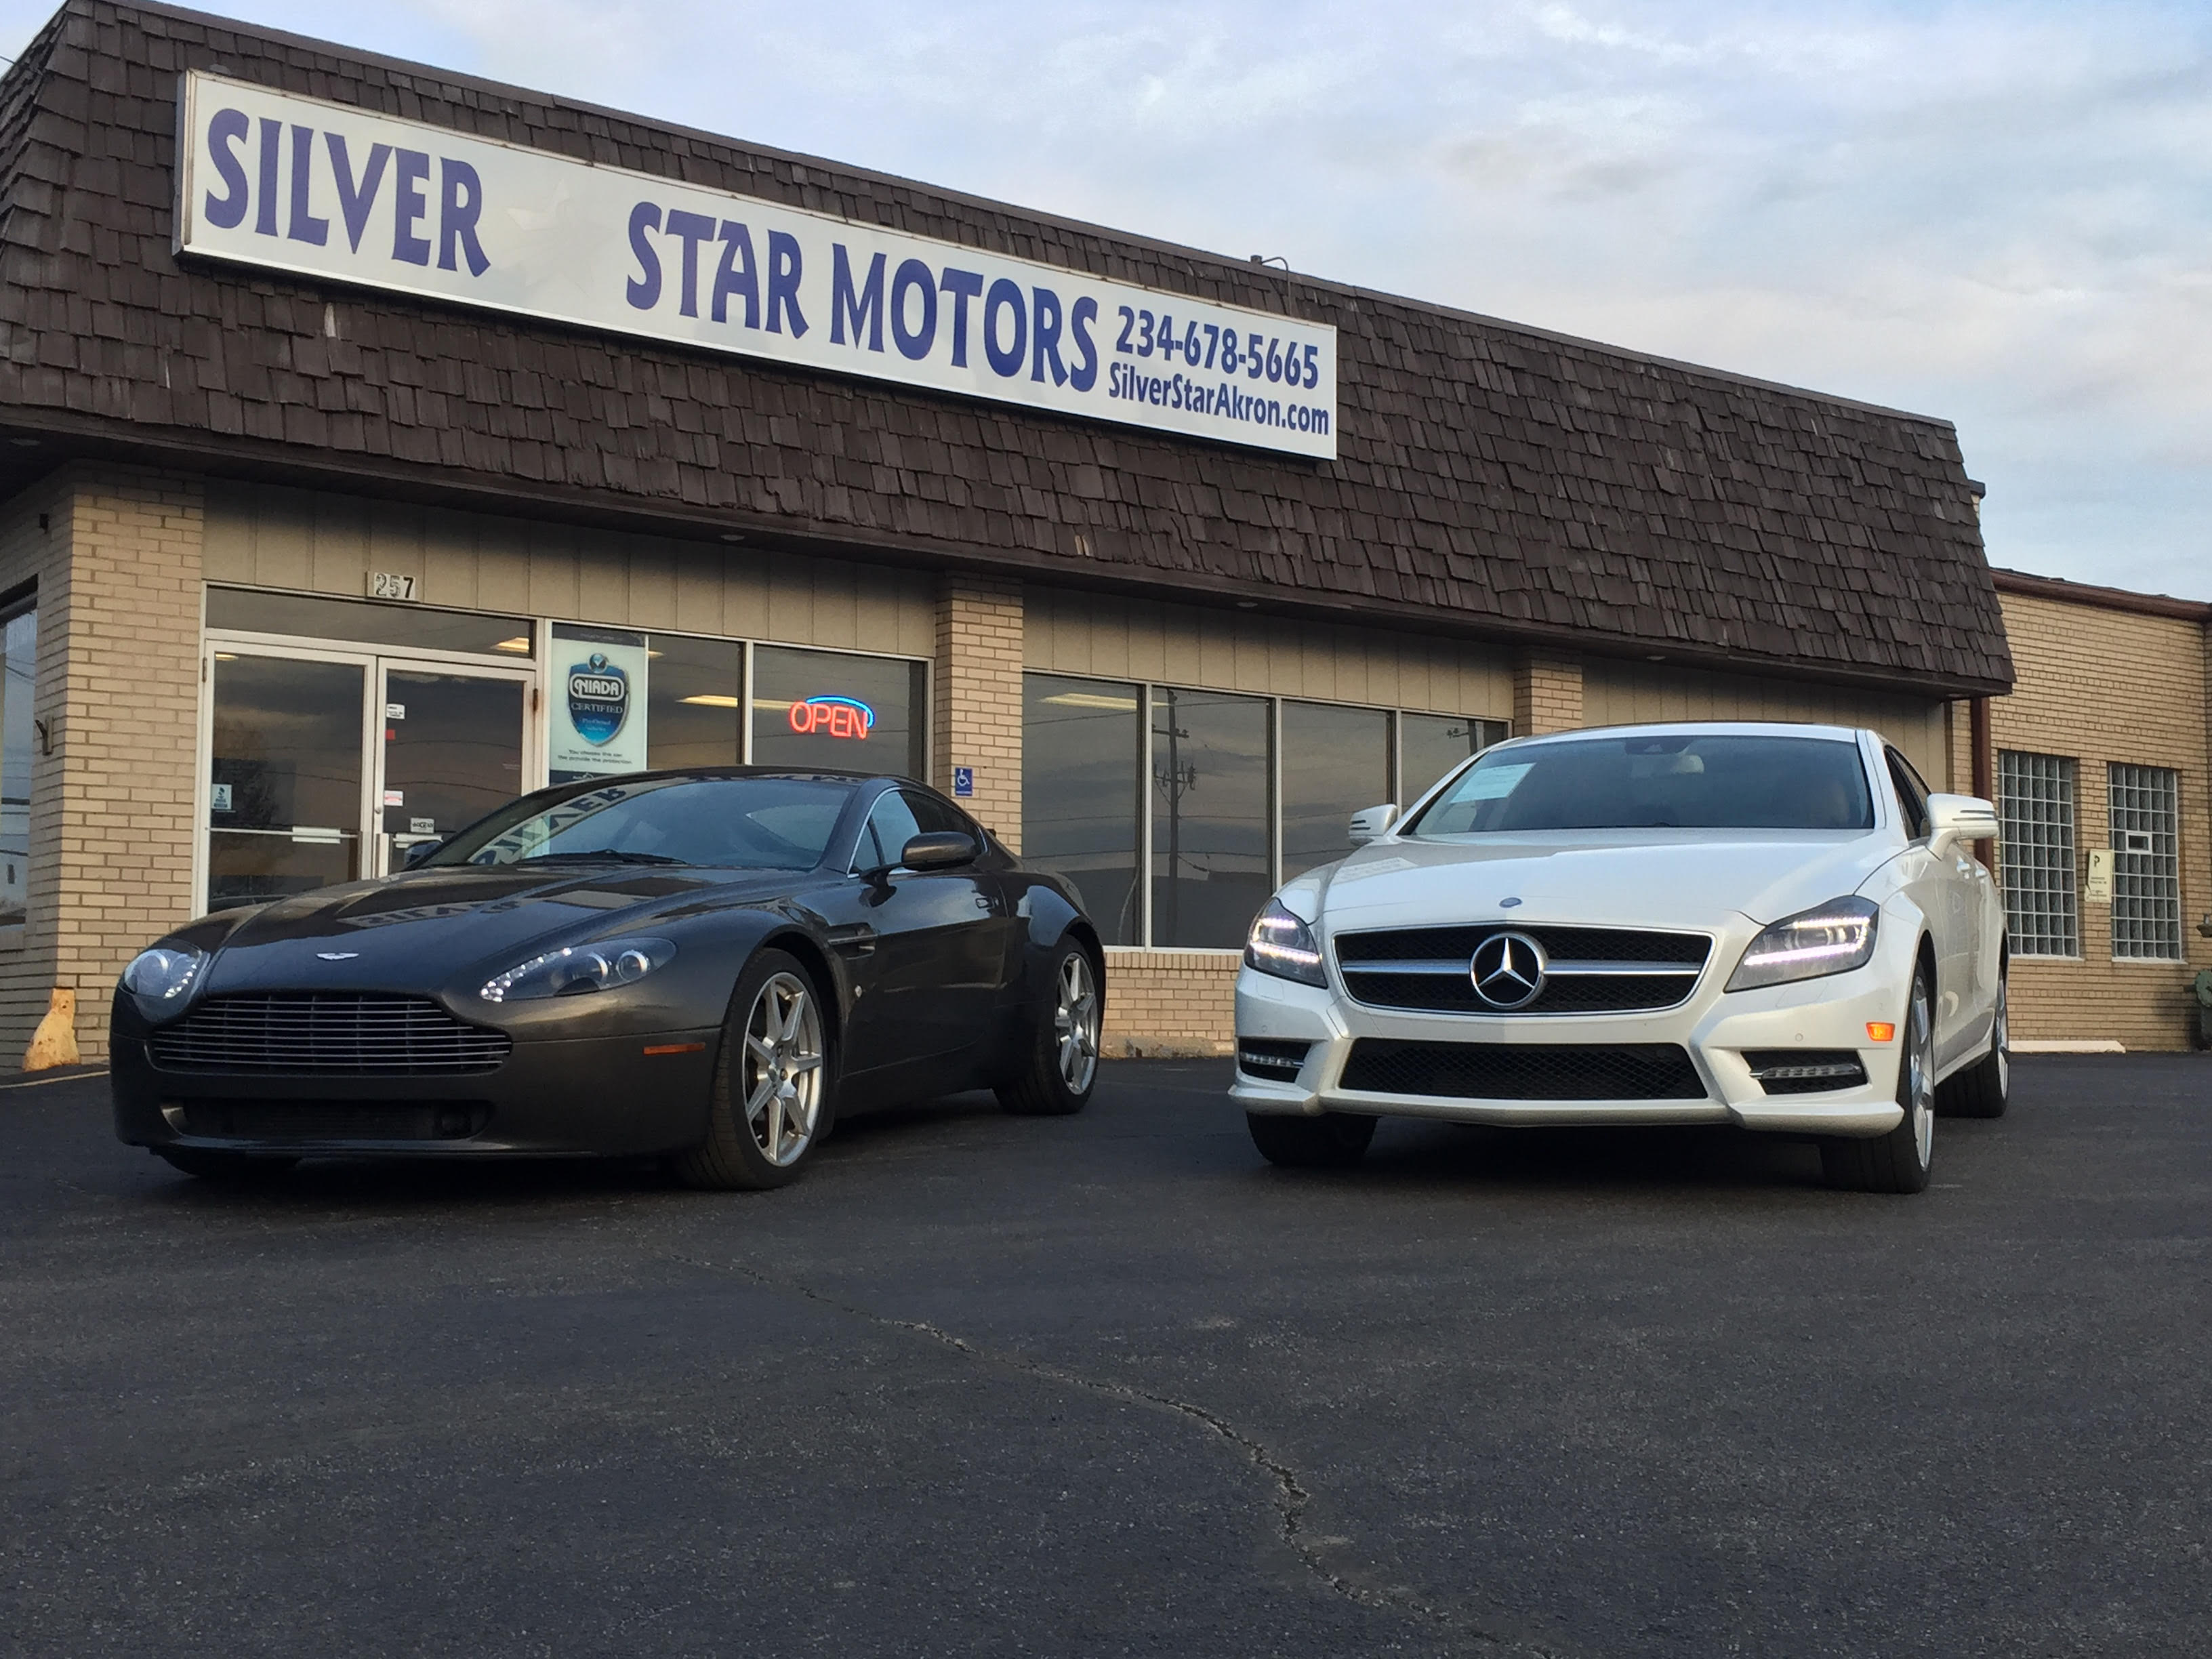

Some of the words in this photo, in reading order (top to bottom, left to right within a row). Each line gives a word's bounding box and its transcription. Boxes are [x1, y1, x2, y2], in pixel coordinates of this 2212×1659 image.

[204, 107, 491, 278] SILVER
[626, 201, 810, 340] STAR
[829, 242, 1099, 392] MOTORS
[1115, 305, 1319, 390] 234-678-5665
[1108, 361, 1330, 436] SilverStarAkron.com
[375, 573, 414, 598] 257
[574, 678, 619, 696] NIADA
[571, 702, 623, 714] CERTIFIED
[790, 701, 868, 739] OPEN
